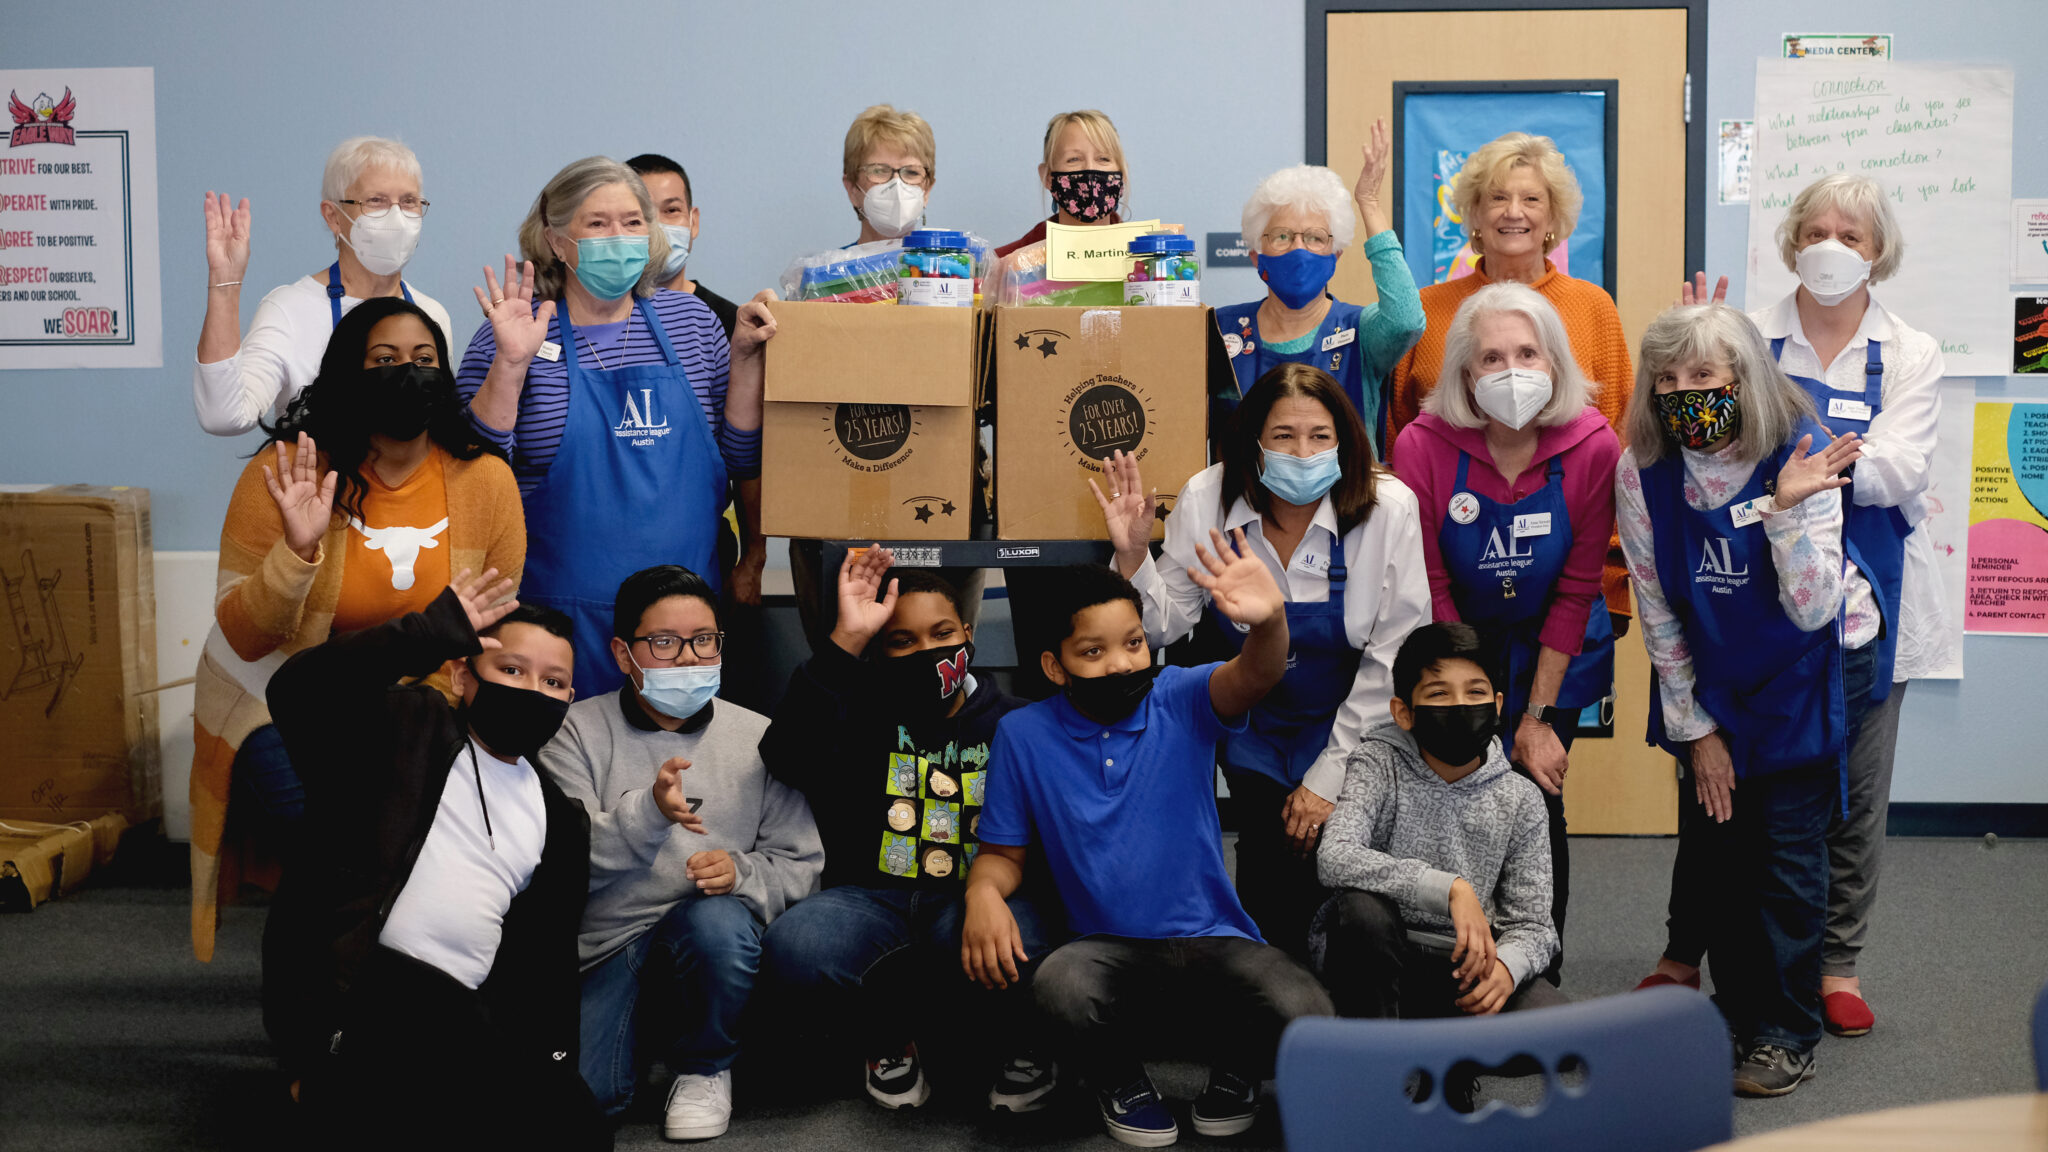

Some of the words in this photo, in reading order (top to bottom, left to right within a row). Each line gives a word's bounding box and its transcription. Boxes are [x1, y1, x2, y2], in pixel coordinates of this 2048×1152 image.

[1805, 47, 1834, 55] MEDIA
[1837, 47, 1874, 55] CENTER
[1808, 104, 1880, 124] relationships
[1895, 96, 1910, 113] do
[1925, 101, 1944, 117] you
[1955, 98, 1971, 109] see
[1786, 132, 1831, 151] between
[1841, 128, 1868, 147] your
[0, 158, 36, 175] TRIVE
[38, 163, 53, 174] FOR
[54, 163, 70, 174] OUR
[72, 162, 93, 174] BEST.
[1837, 161, 1845, 170] a
[1918, 185, 1940, 202] you
[1950, 176, 1976, 193] look
[0, 194, 47, 211] PERATE
[50, 200, 71, 210] WITH
[73, 200, 98, 210] PRIDE.
[37, 236, 46, 246] TO
[48, 236, 57, 246] BE
[59, 236, 97, 247] POSITIVE.
[1067, 251, 1080, 259] R.
[49, 272, 96, 284] OURSELVES,
[14, 291, 29, 301] AND
[31, 291, 46, 301] OUR
[48, 290, 81, 301] SCHOOL.
[44, 318, 62, 334] WE
[64, 310, 118, 336] SOAR!
[1064, 378, 1096, 405] Helping
[1096, 374, 1137, 391] Teachers
[614, 389, 668, 429] AL
[1082, 403, 1101, 420] FOR
[1101, 398, 1126, 416] OVER
[614, 429, 648, 437] assistance
[844, 420, 862, 443] 25
[863, 411, 905, 440] YEARS!
[1080, 421, 1098, 445] 25
[1097, 411, 1139, 441] YEARS!
[631, 438, 655, 446] Austin
[842, 456, 865, 471] Make
[873, 448, 913, 473] Difference
[1078, 457, 1101, 473] Make
[1006, 548, 1038, 556] LUXOR
[1479, 525, 1532, 562] AL
[1695, 536, 1749, 576] AL
[1478, 560, 1510, 570] assistance
[1495, 569, 1517, 577] Austin
[1695, 573, 1726, 583] assistance
[1711, 585, 1733, 594] Austin
[936, 647, 969, 700] M
